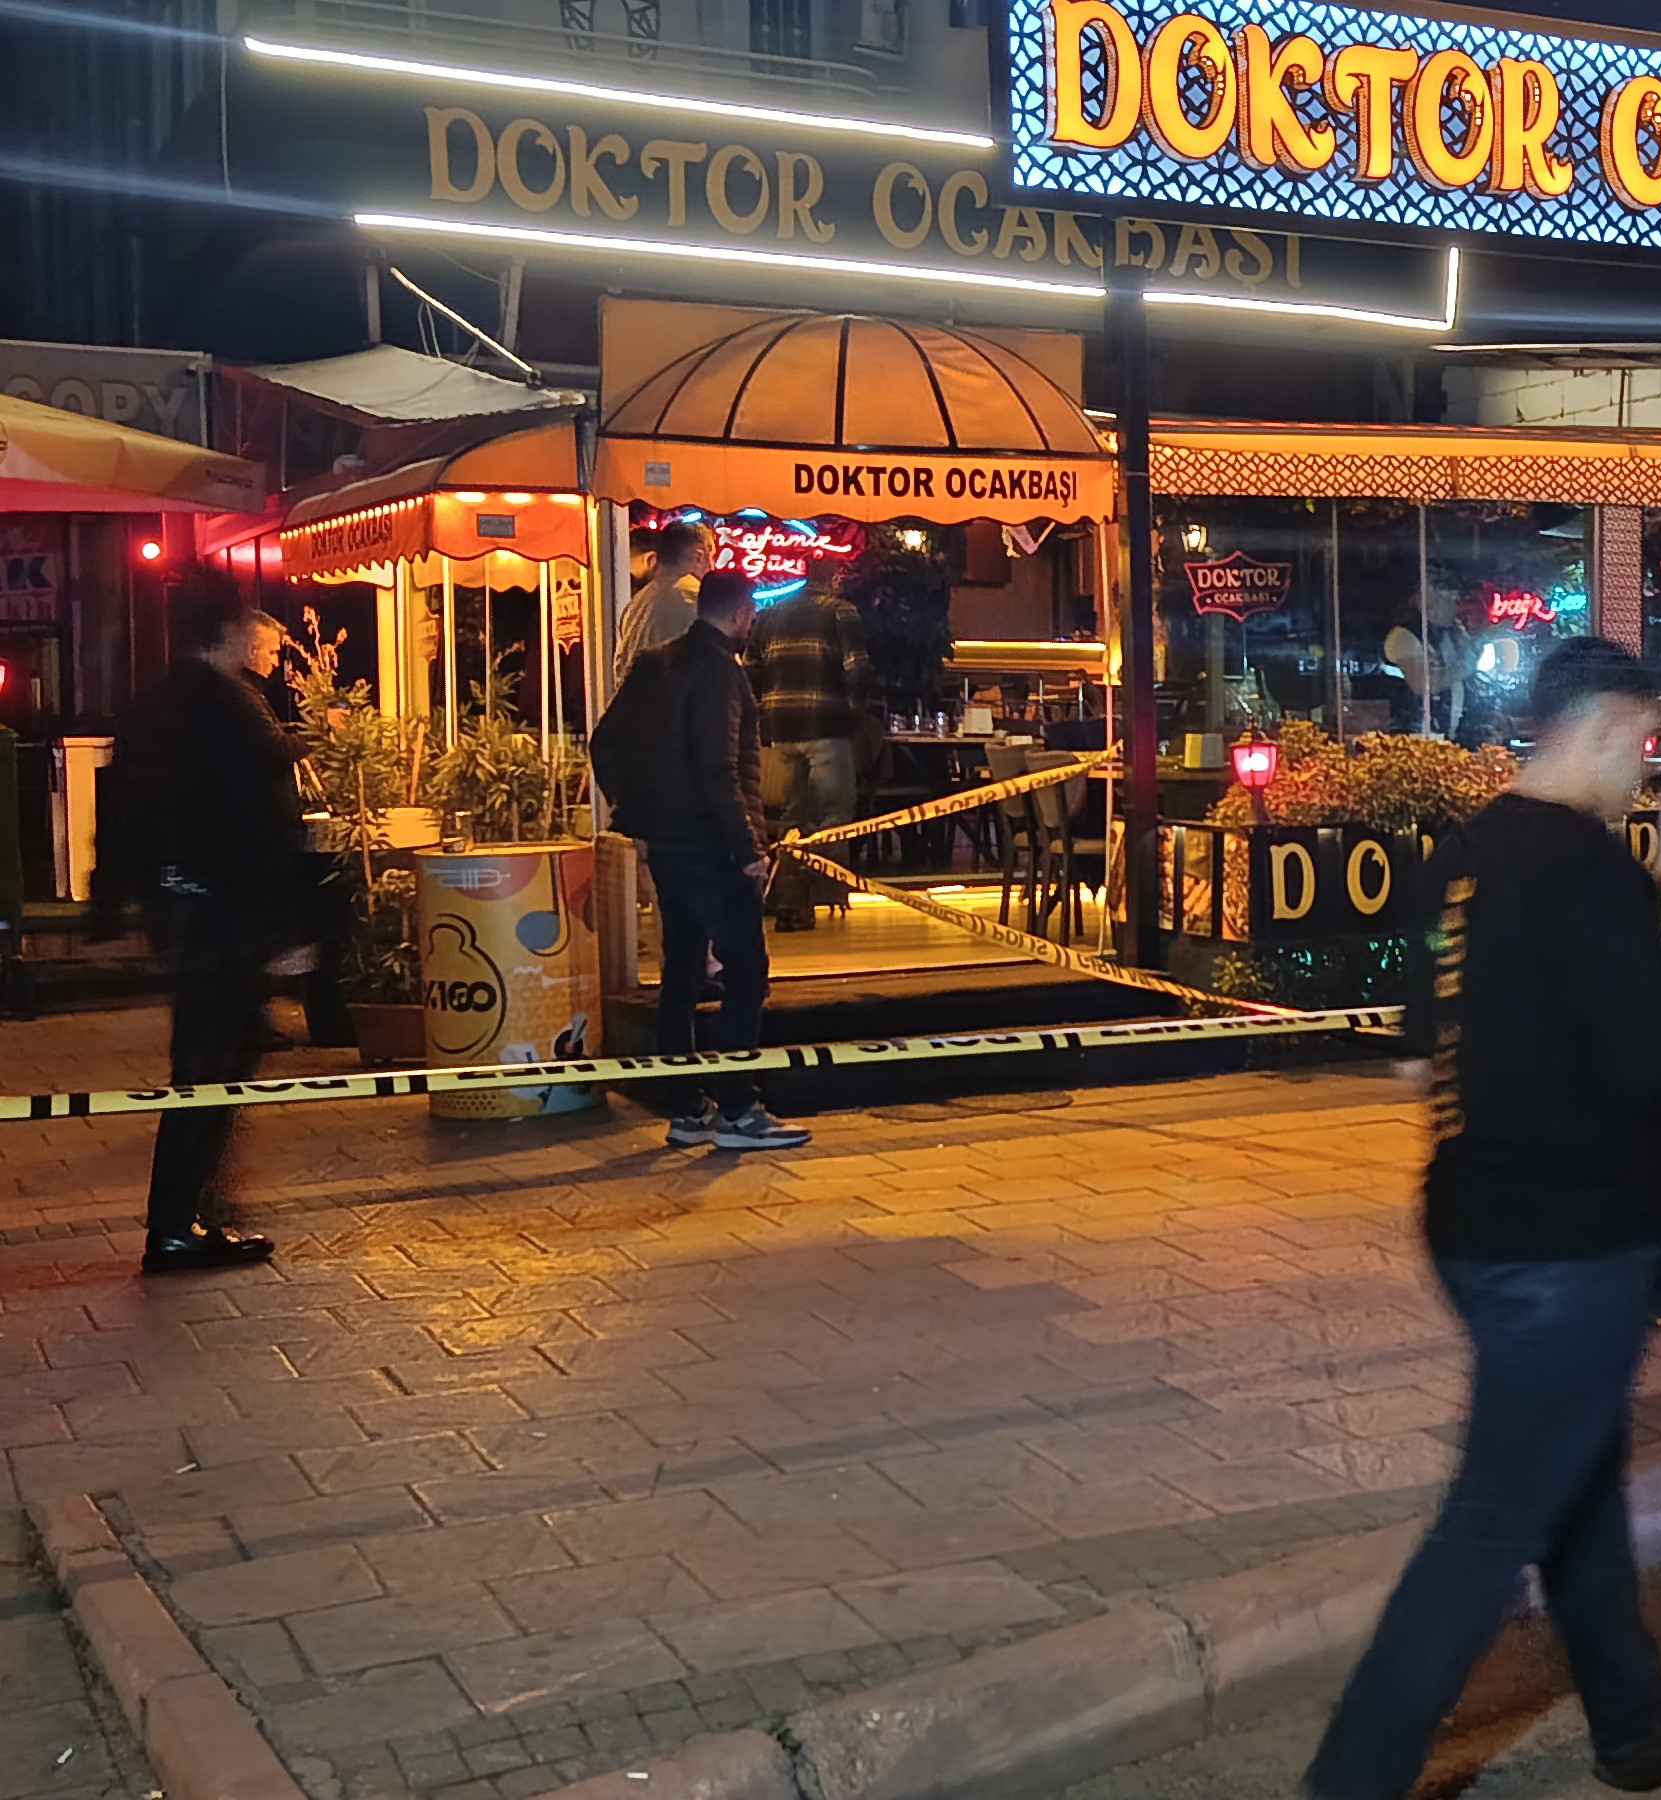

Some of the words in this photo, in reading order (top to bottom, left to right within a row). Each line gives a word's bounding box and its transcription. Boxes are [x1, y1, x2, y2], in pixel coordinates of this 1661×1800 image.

[1045, 0, 1573, 197] DOKTOR
[422, 106, 836, 243] DOKTOR
[794, 462, 935, 498] DOKTOR
[945, 467, 1078, 508] OCAKBAŞI
[1197, 568, 1281, 588] DOKTOR
